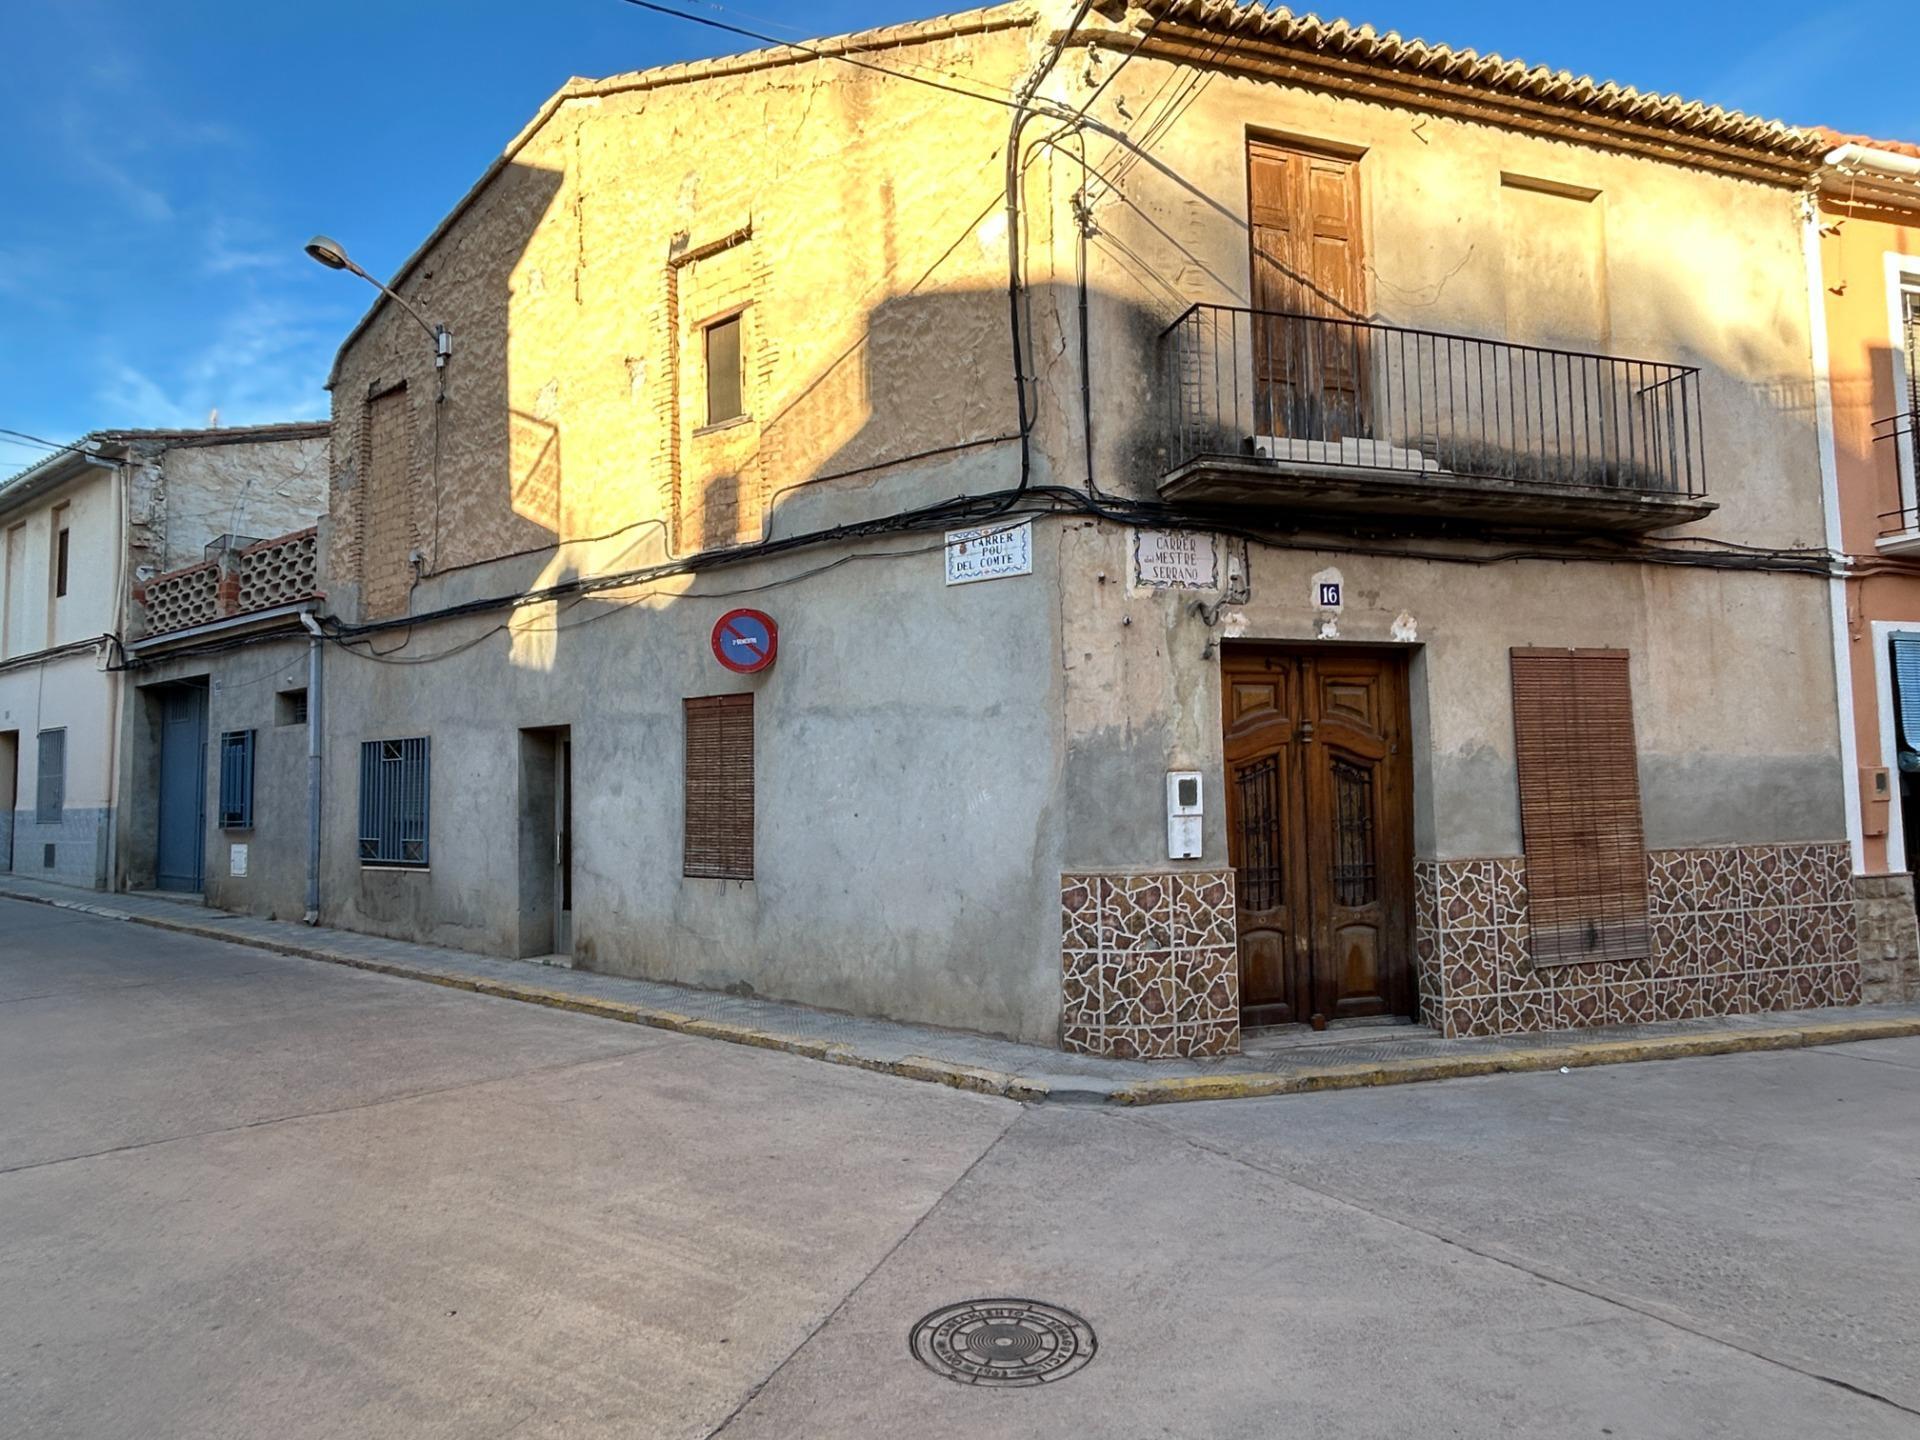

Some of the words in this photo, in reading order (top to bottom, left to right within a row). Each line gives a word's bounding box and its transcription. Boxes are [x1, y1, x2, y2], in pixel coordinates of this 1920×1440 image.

[972, 532, 1014, 548] CARRER
[1156, 537, 1196, 552] CARRER
[982, 545, 1003, 557] POU
[957, 561, 975, 571] DEL
[980, 554, 1014, 568] COMTE
[1155, 552, 1197, 566] MESTRE
[1153, 566, 1198, 580] SERRANO
[1323, 586, 1337, 603] 16
